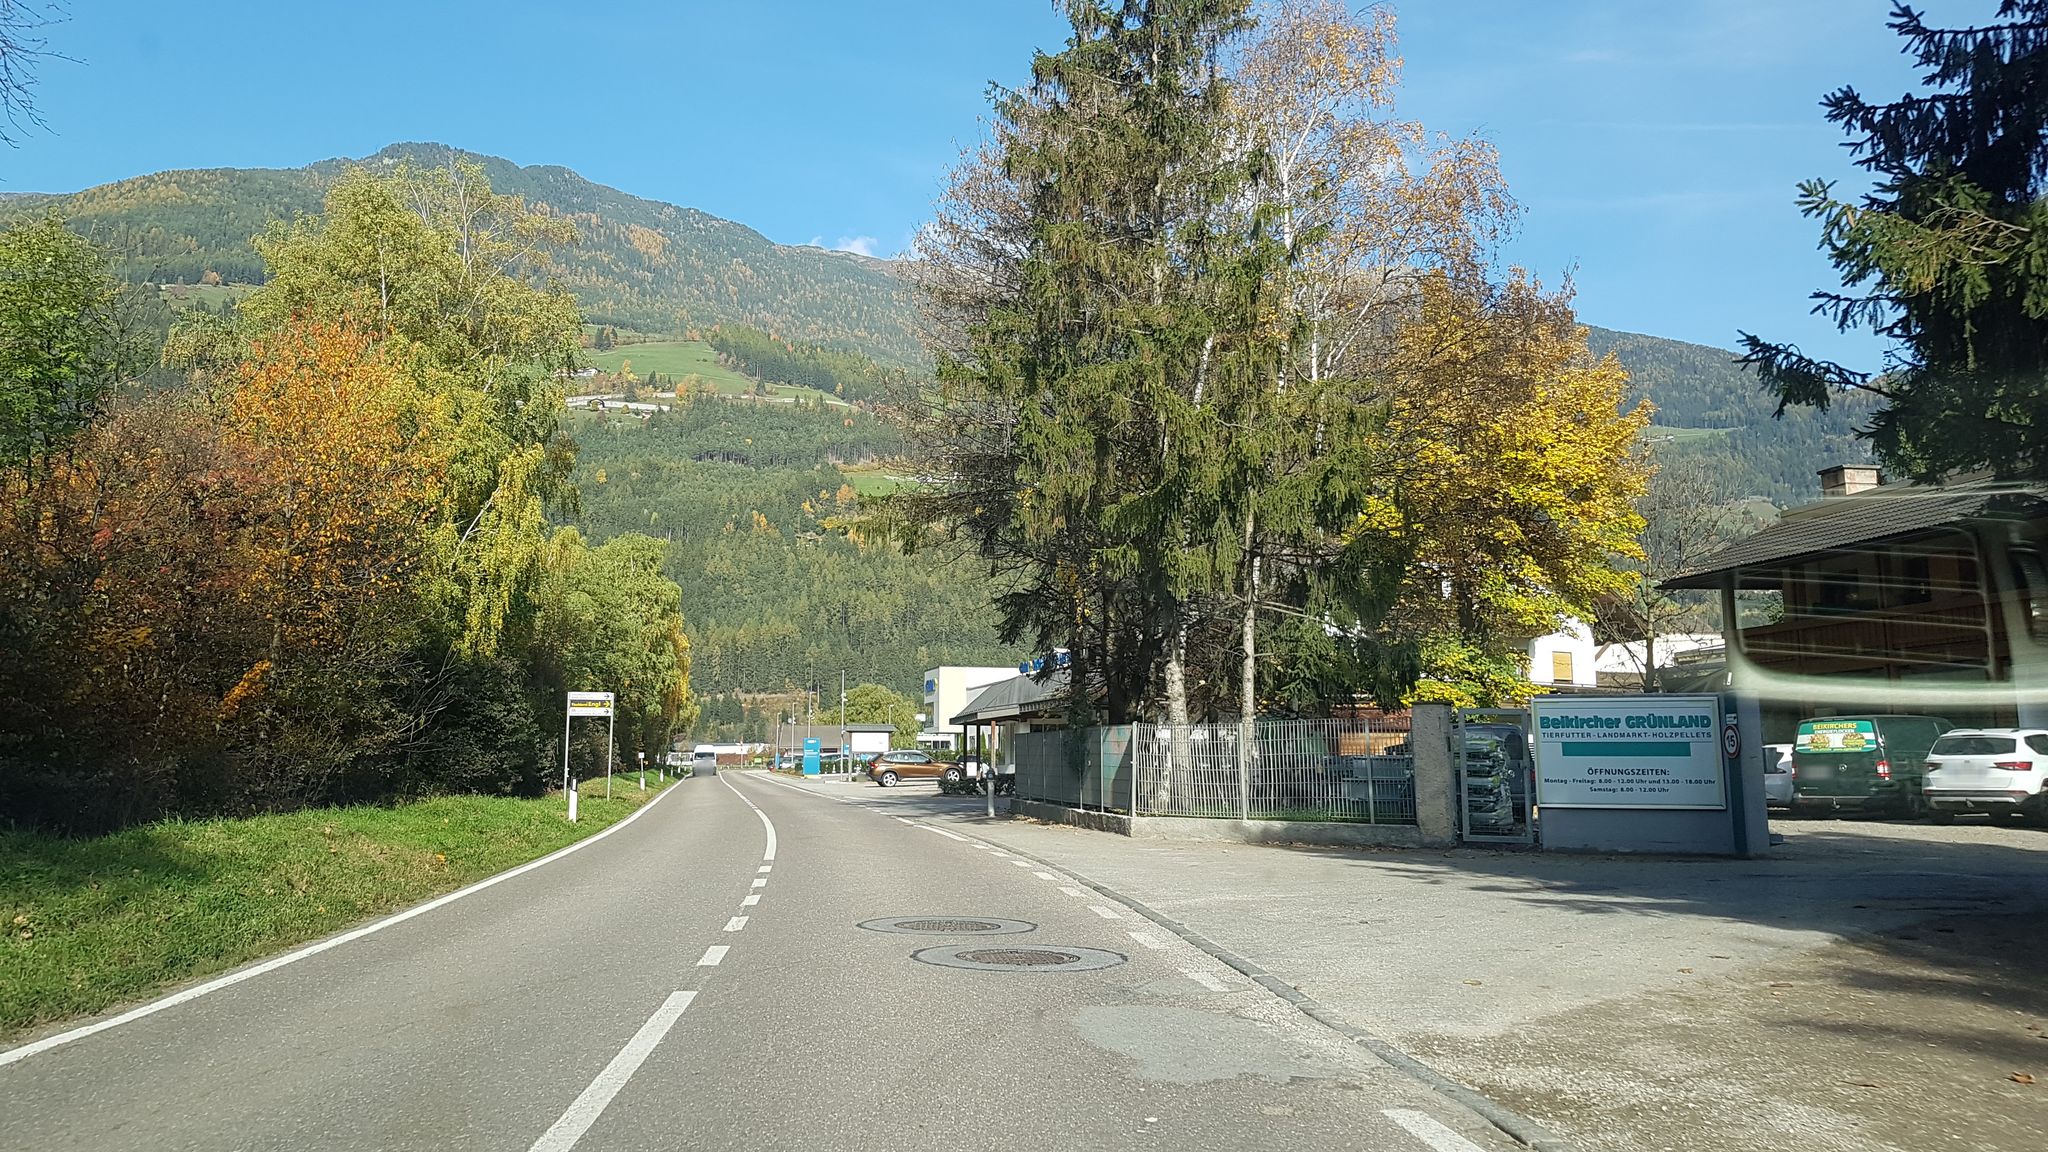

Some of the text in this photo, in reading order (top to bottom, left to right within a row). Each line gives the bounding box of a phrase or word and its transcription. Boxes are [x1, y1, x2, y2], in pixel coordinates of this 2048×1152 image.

[1625, 713, 1712, 729] GRÜNLAND
[1726, 735, 1736, 748] 15
[1587, 767, 1670, 776] ÖFFNUNGSZEITEN:
